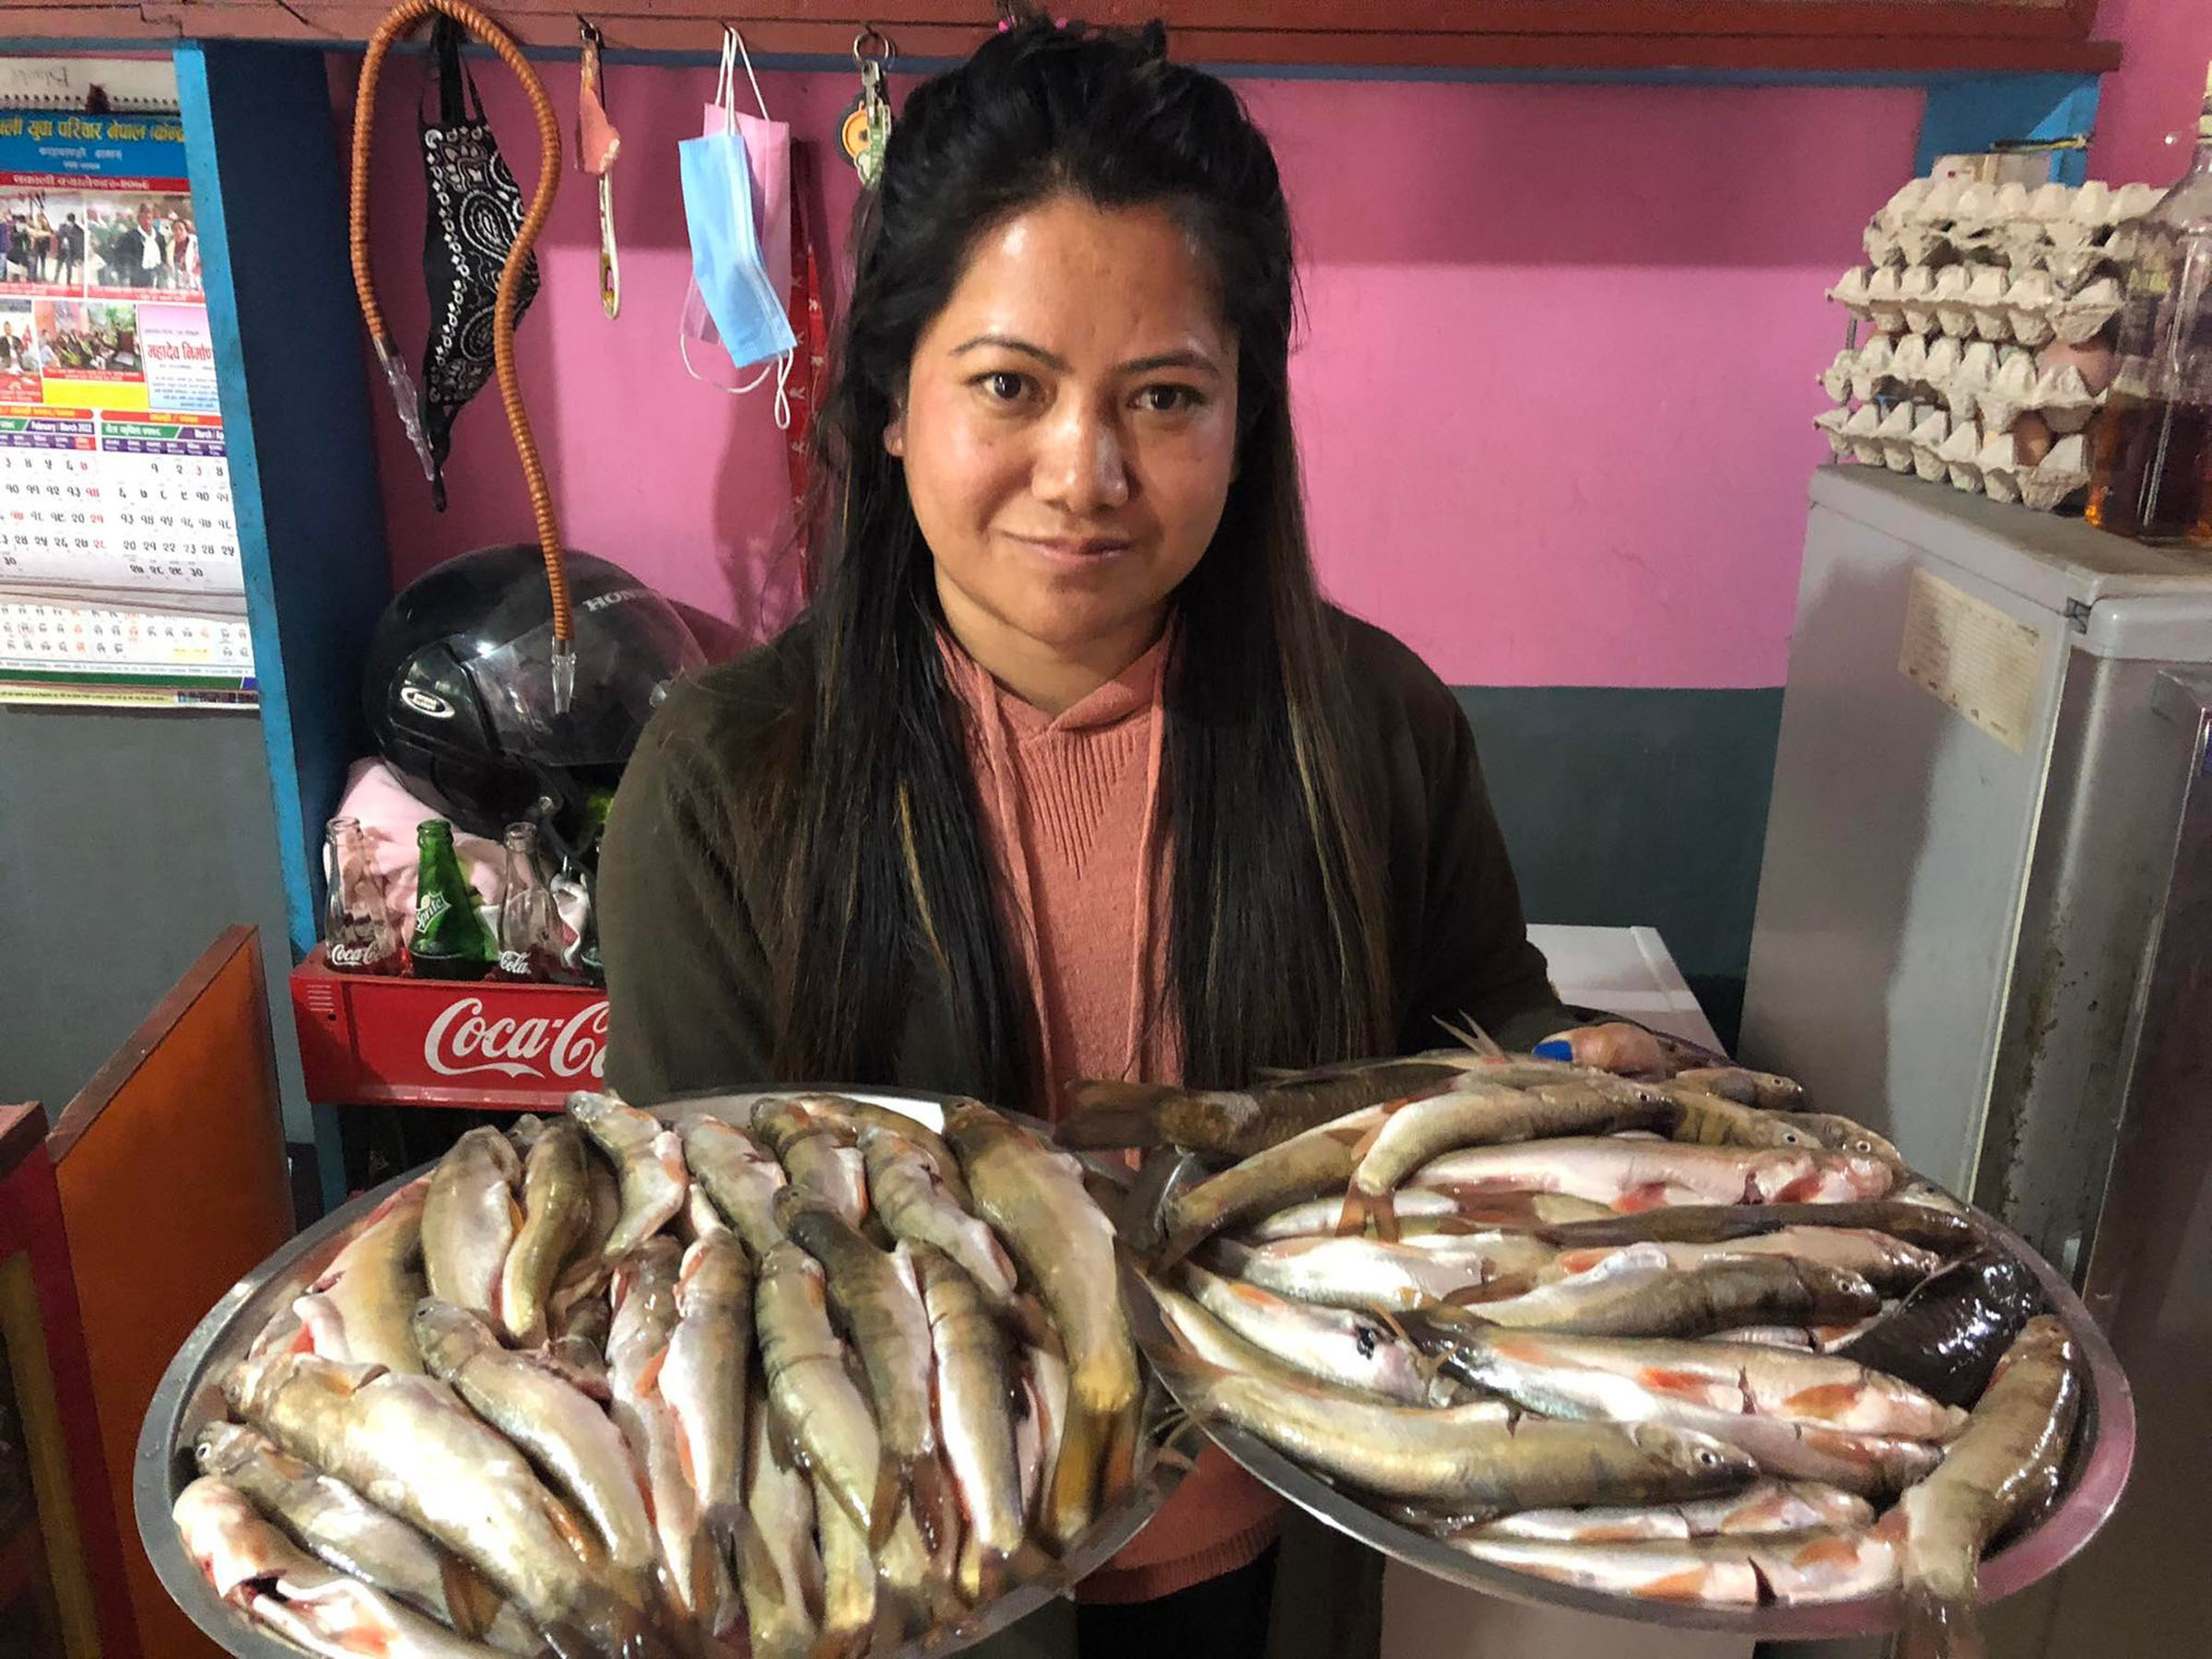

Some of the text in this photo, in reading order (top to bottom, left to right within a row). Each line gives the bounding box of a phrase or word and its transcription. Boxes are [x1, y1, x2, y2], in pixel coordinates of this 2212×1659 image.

[57, 116, 103, 139] परिवार
[107, 120, 147, 141] नेपाल
[147, 341, 180, 360] महादेव
[0, 535, 8, 545] ३
[582, 590, 645, 612] HON
[332, 941, 380, 967] Coca-C
[424, 997, 610, 1078] Coca-C
